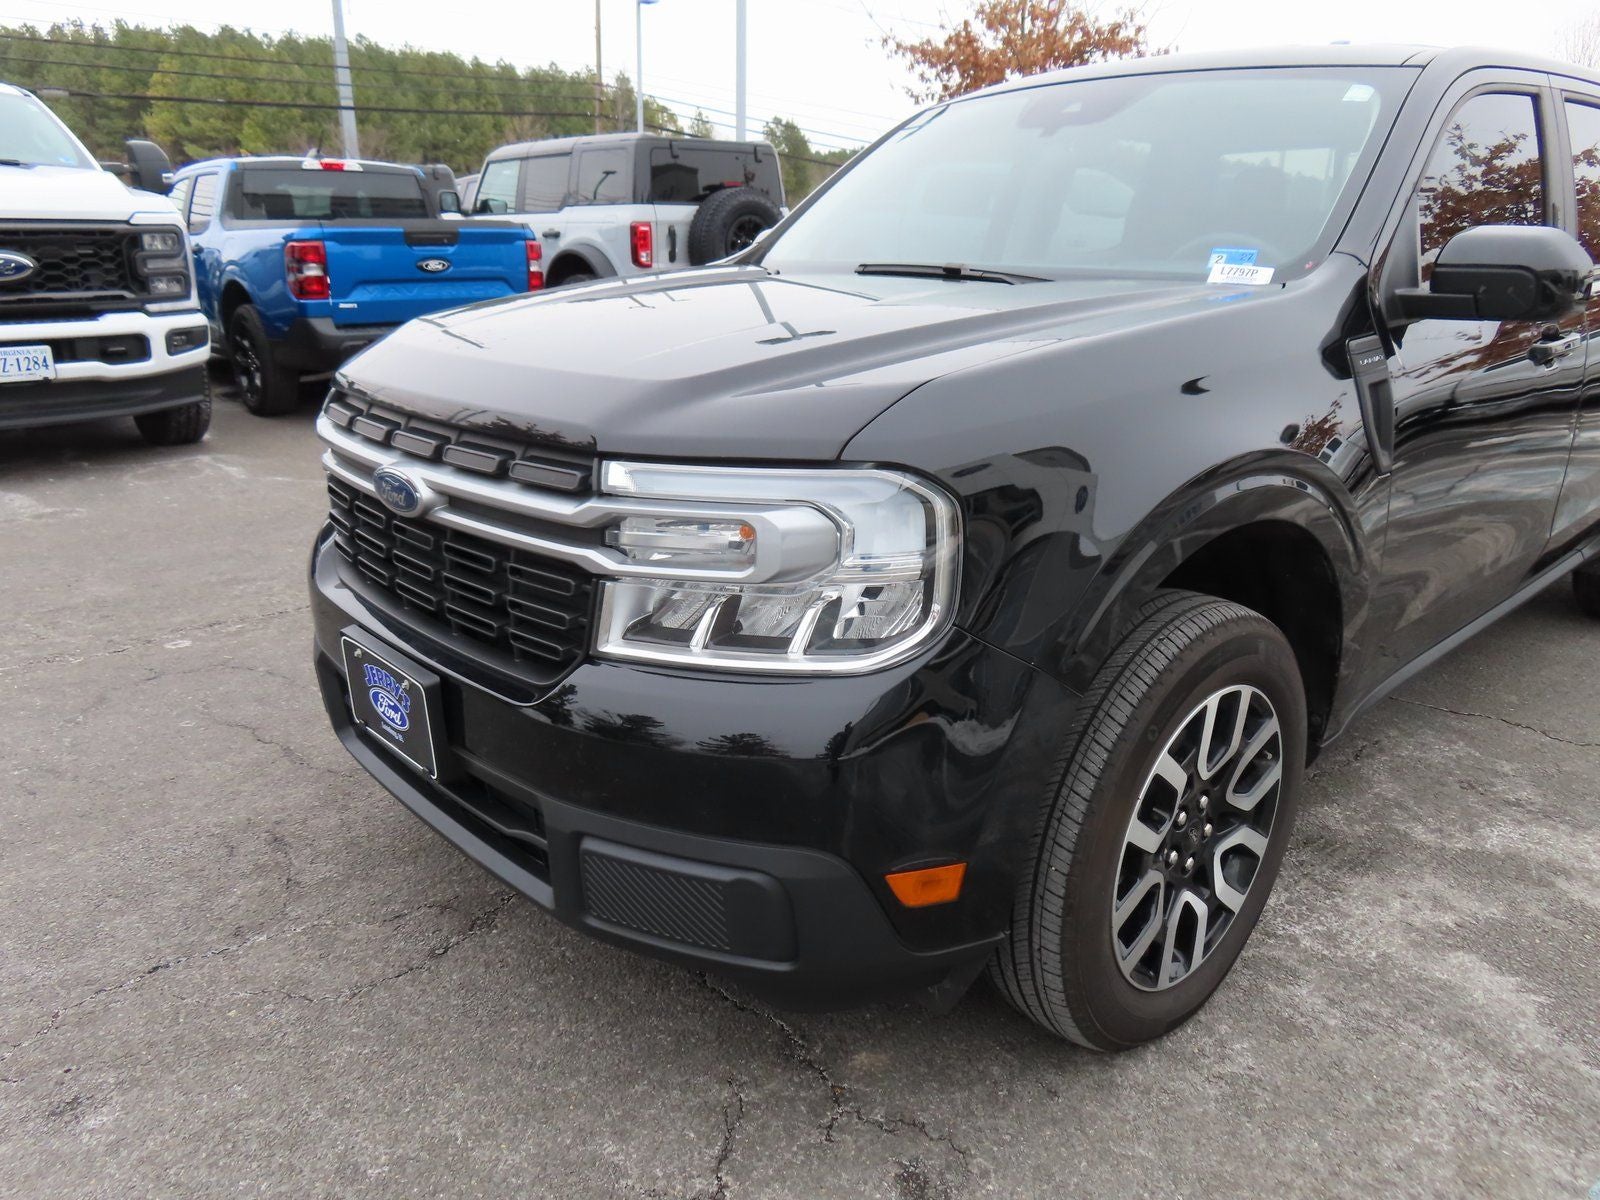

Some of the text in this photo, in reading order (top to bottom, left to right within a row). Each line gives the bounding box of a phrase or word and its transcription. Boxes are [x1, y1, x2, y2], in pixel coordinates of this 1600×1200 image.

[1214, 254, 1224, 264] 2
[361, 284, 503, 297] MAVERICK
[0, 356, 49, 373] Z-1284
[380, 476, 406, 506] Ford
[363, 663, 411, 713] JERRY'S
[377, 692, 402, 725] Ford
